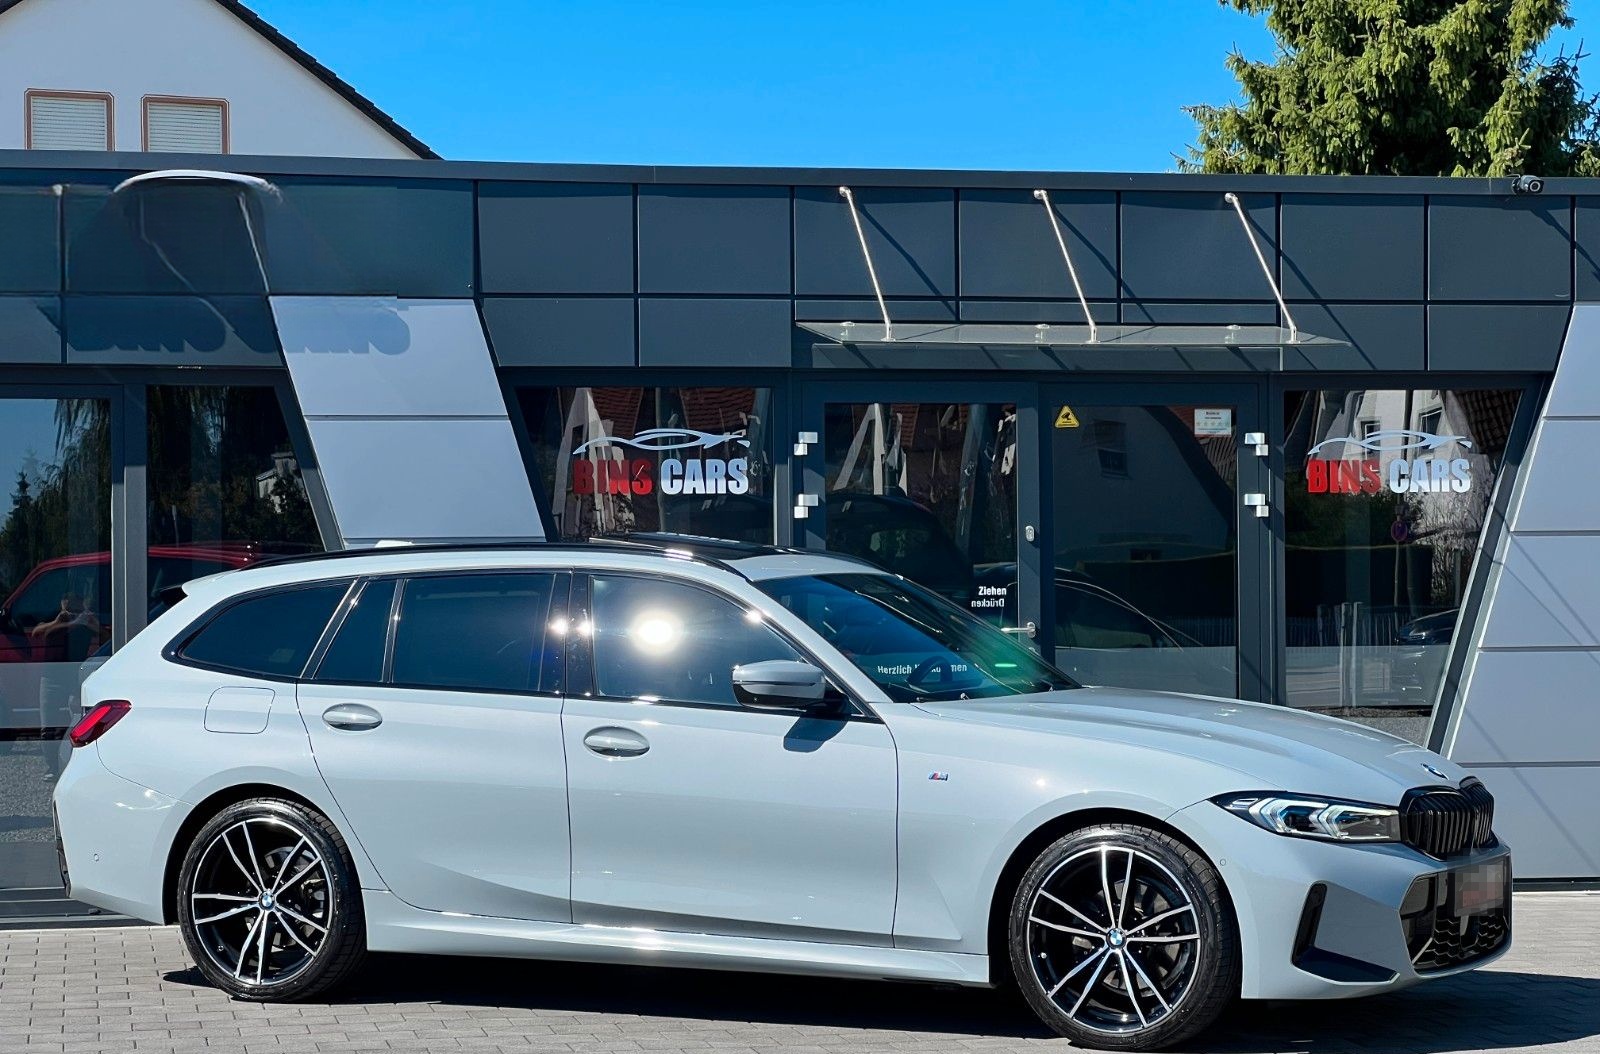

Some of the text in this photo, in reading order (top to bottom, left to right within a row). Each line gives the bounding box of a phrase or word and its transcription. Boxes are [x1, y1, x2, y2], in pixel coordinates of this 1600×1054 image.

[572, 458, 748, 495] BINS CARS
[1307, 458, 1471, 494] BINS CARS
[978, 585, 1007, 596] Ziehen
[877, 665, 912, 675] Herzlich
